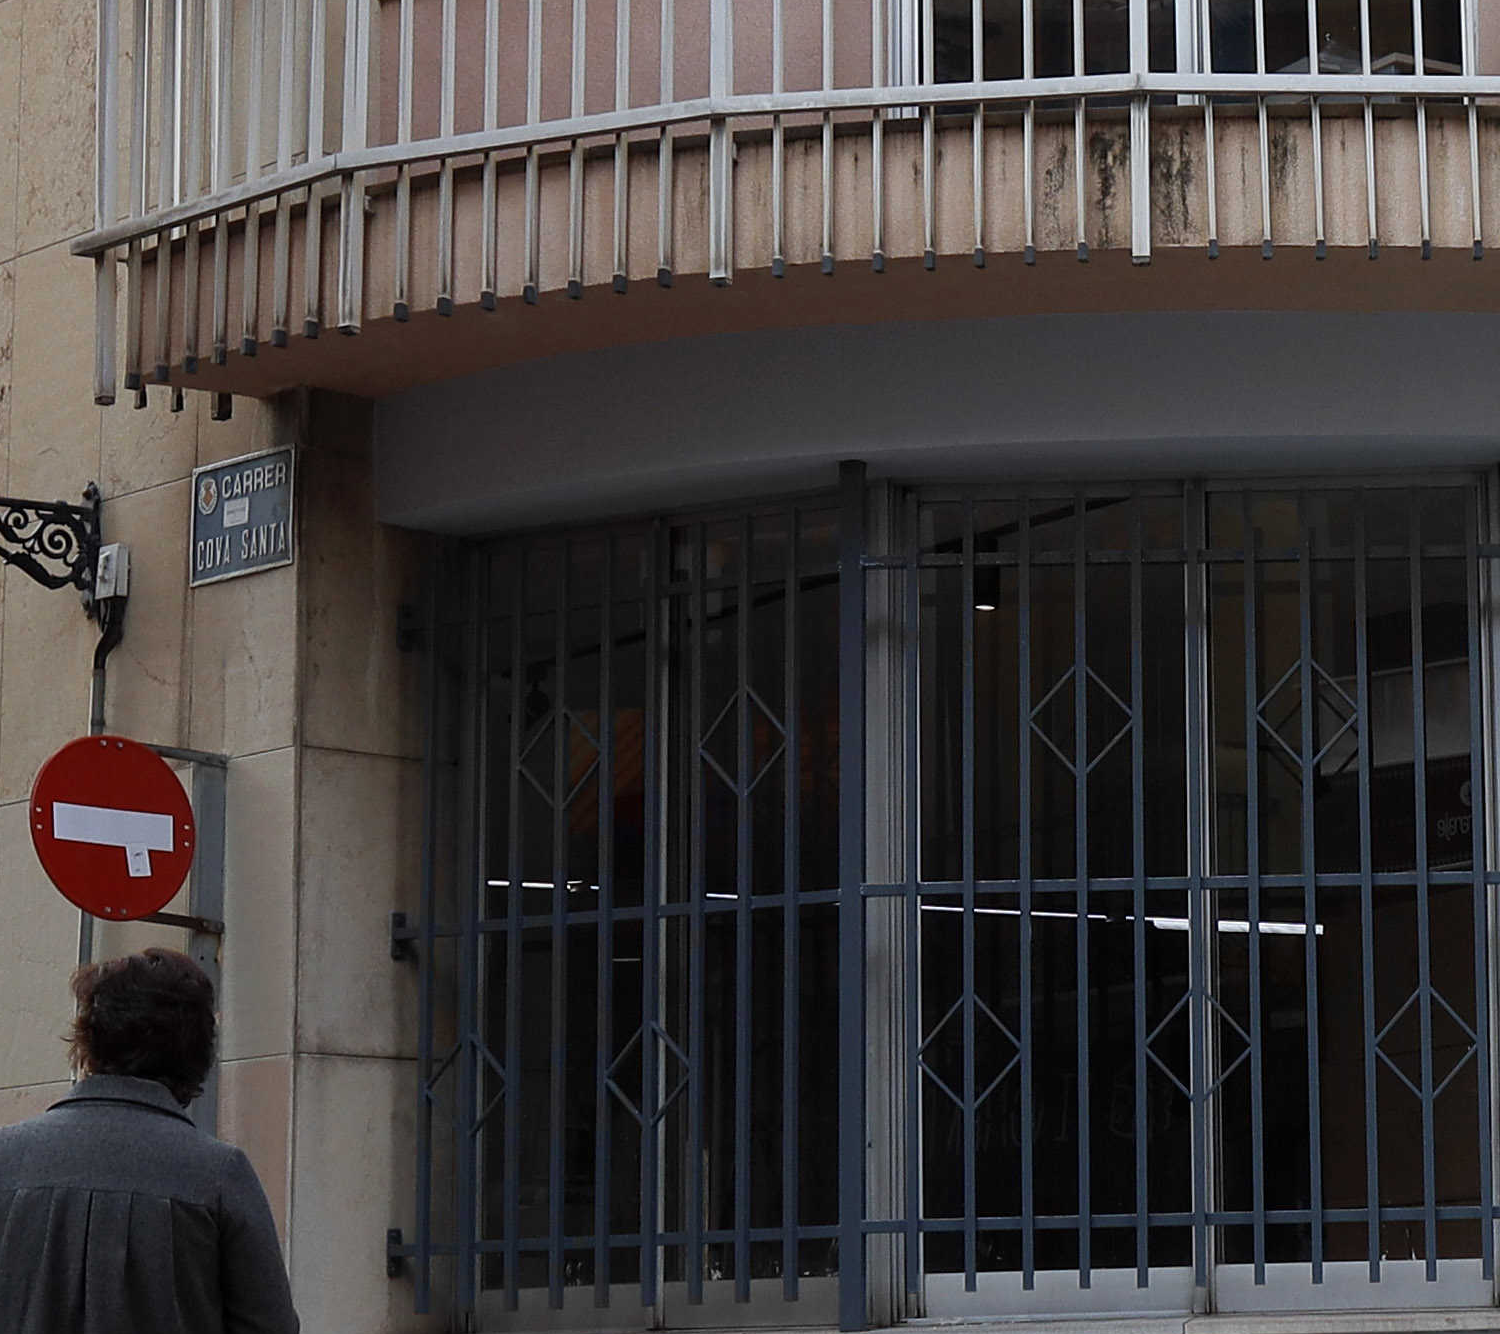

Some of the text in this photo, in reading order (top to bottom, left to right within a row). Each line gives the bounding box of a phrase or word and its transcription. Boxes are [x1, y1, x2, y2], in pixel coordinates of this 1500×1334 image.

[221, 462, 286, 499] CARRER
[196, 521, 285, 571] COVA SANTA
